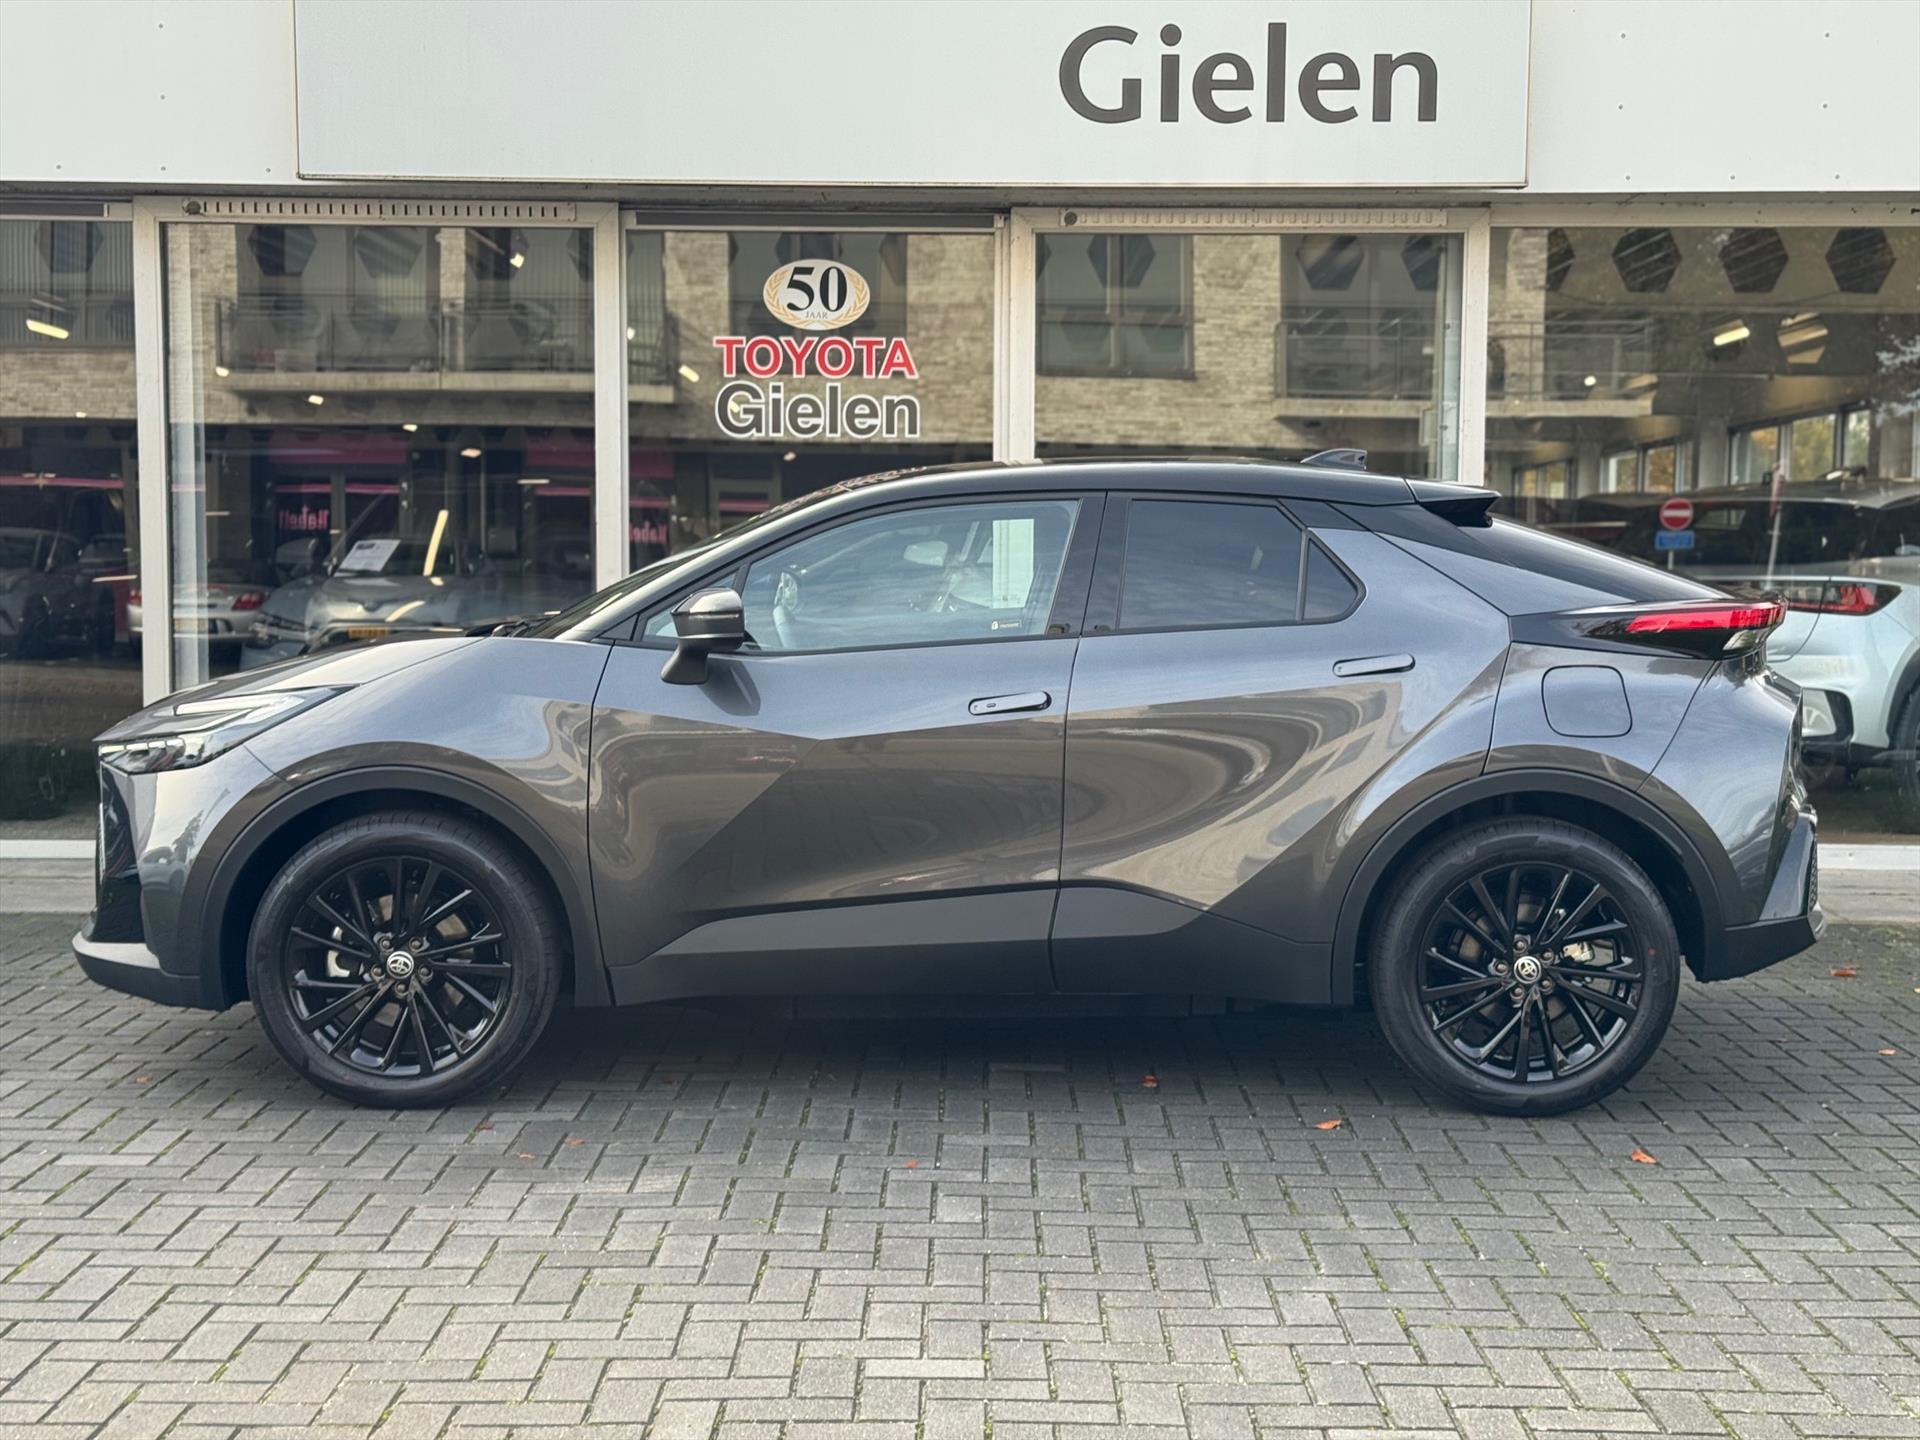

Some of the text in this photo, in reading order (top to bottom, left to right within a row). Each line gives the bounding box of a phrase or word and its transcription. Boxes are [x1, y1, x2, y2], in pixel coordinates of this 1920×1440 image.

[1059, 22, 1438, 124] Gielen
[786, 266, 848, 312] 50
[805, 311, 828, 319] JAAR
[713, 336, 919, 379] TOYOTA
[715, 381, 920, 438] Gielen
